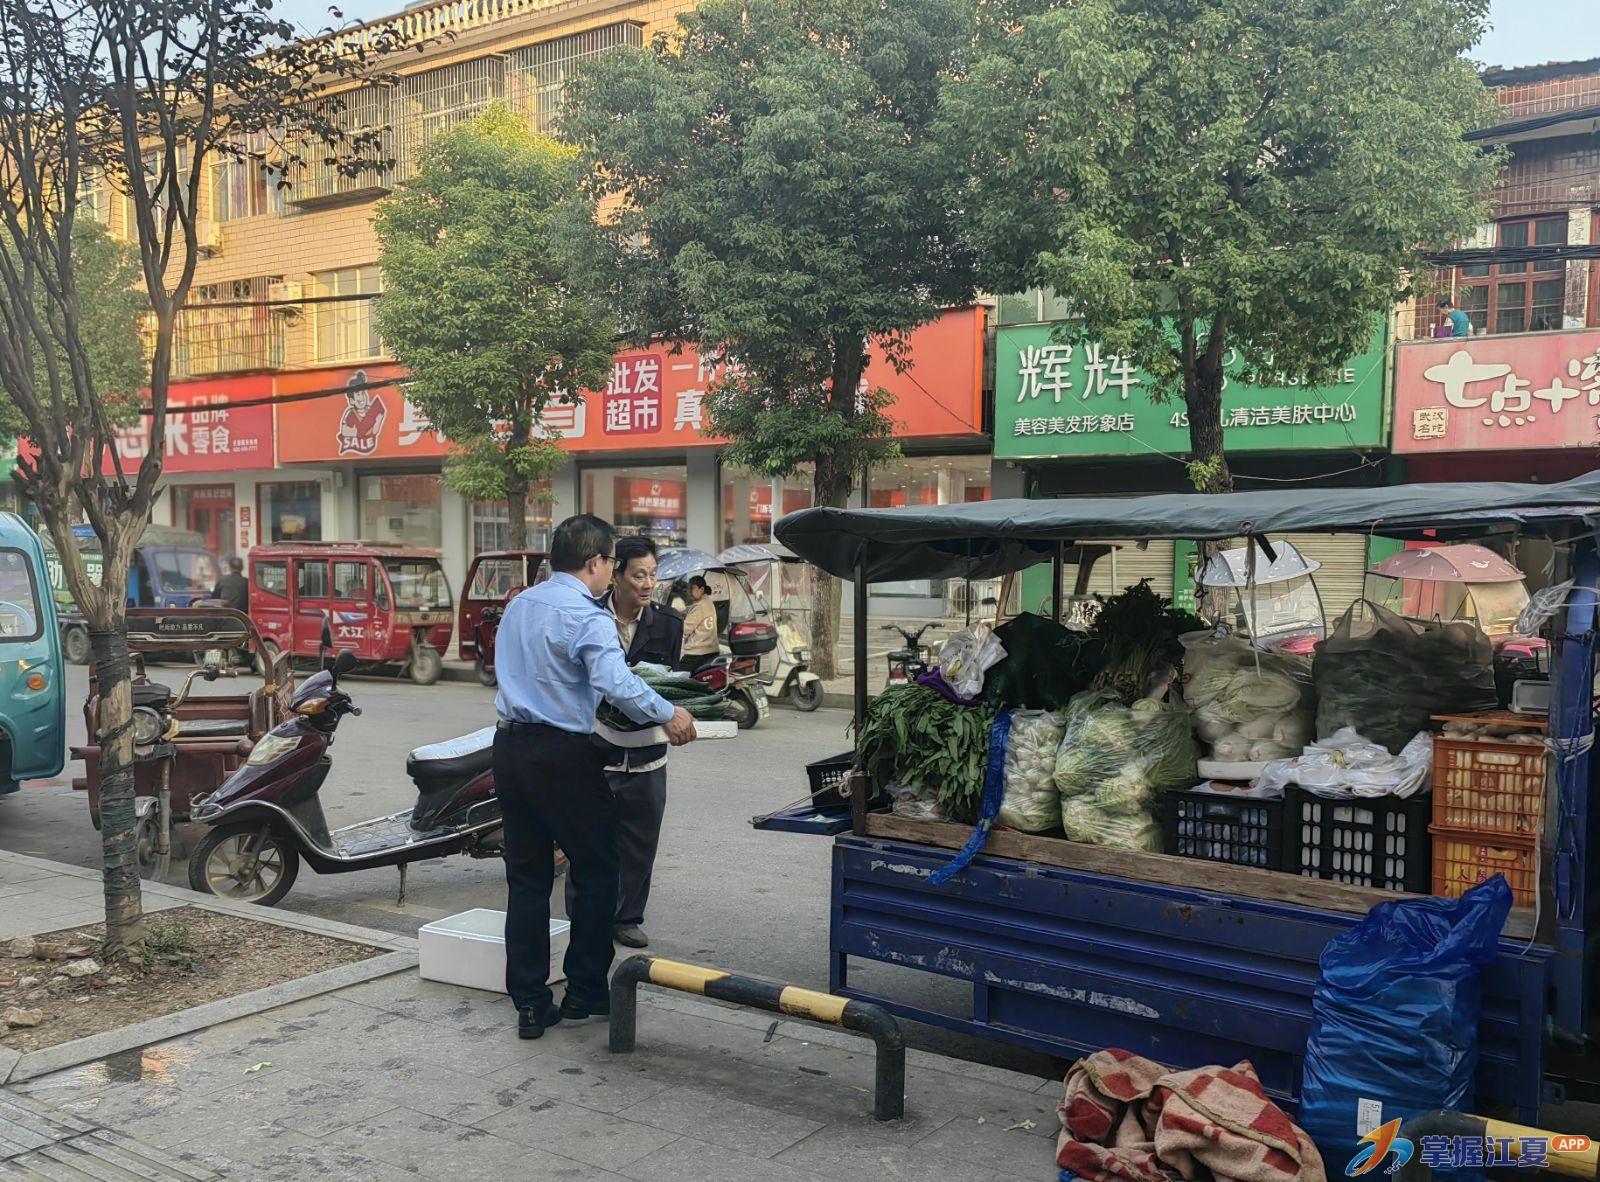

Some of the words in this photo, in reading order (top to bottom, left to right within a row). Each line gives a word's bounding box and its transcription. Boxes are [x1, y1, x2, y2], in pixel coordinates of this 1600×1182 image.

[608, 358, 659, 395] 批发
[606, 397, 658, 432] 超市
[1014, 412, 1136, 437] 美容美发形象店
[192, 425, 230, 454] 零食
[343, 435, 374, 450] SALE
[338, 625, 364, 638] 大江
